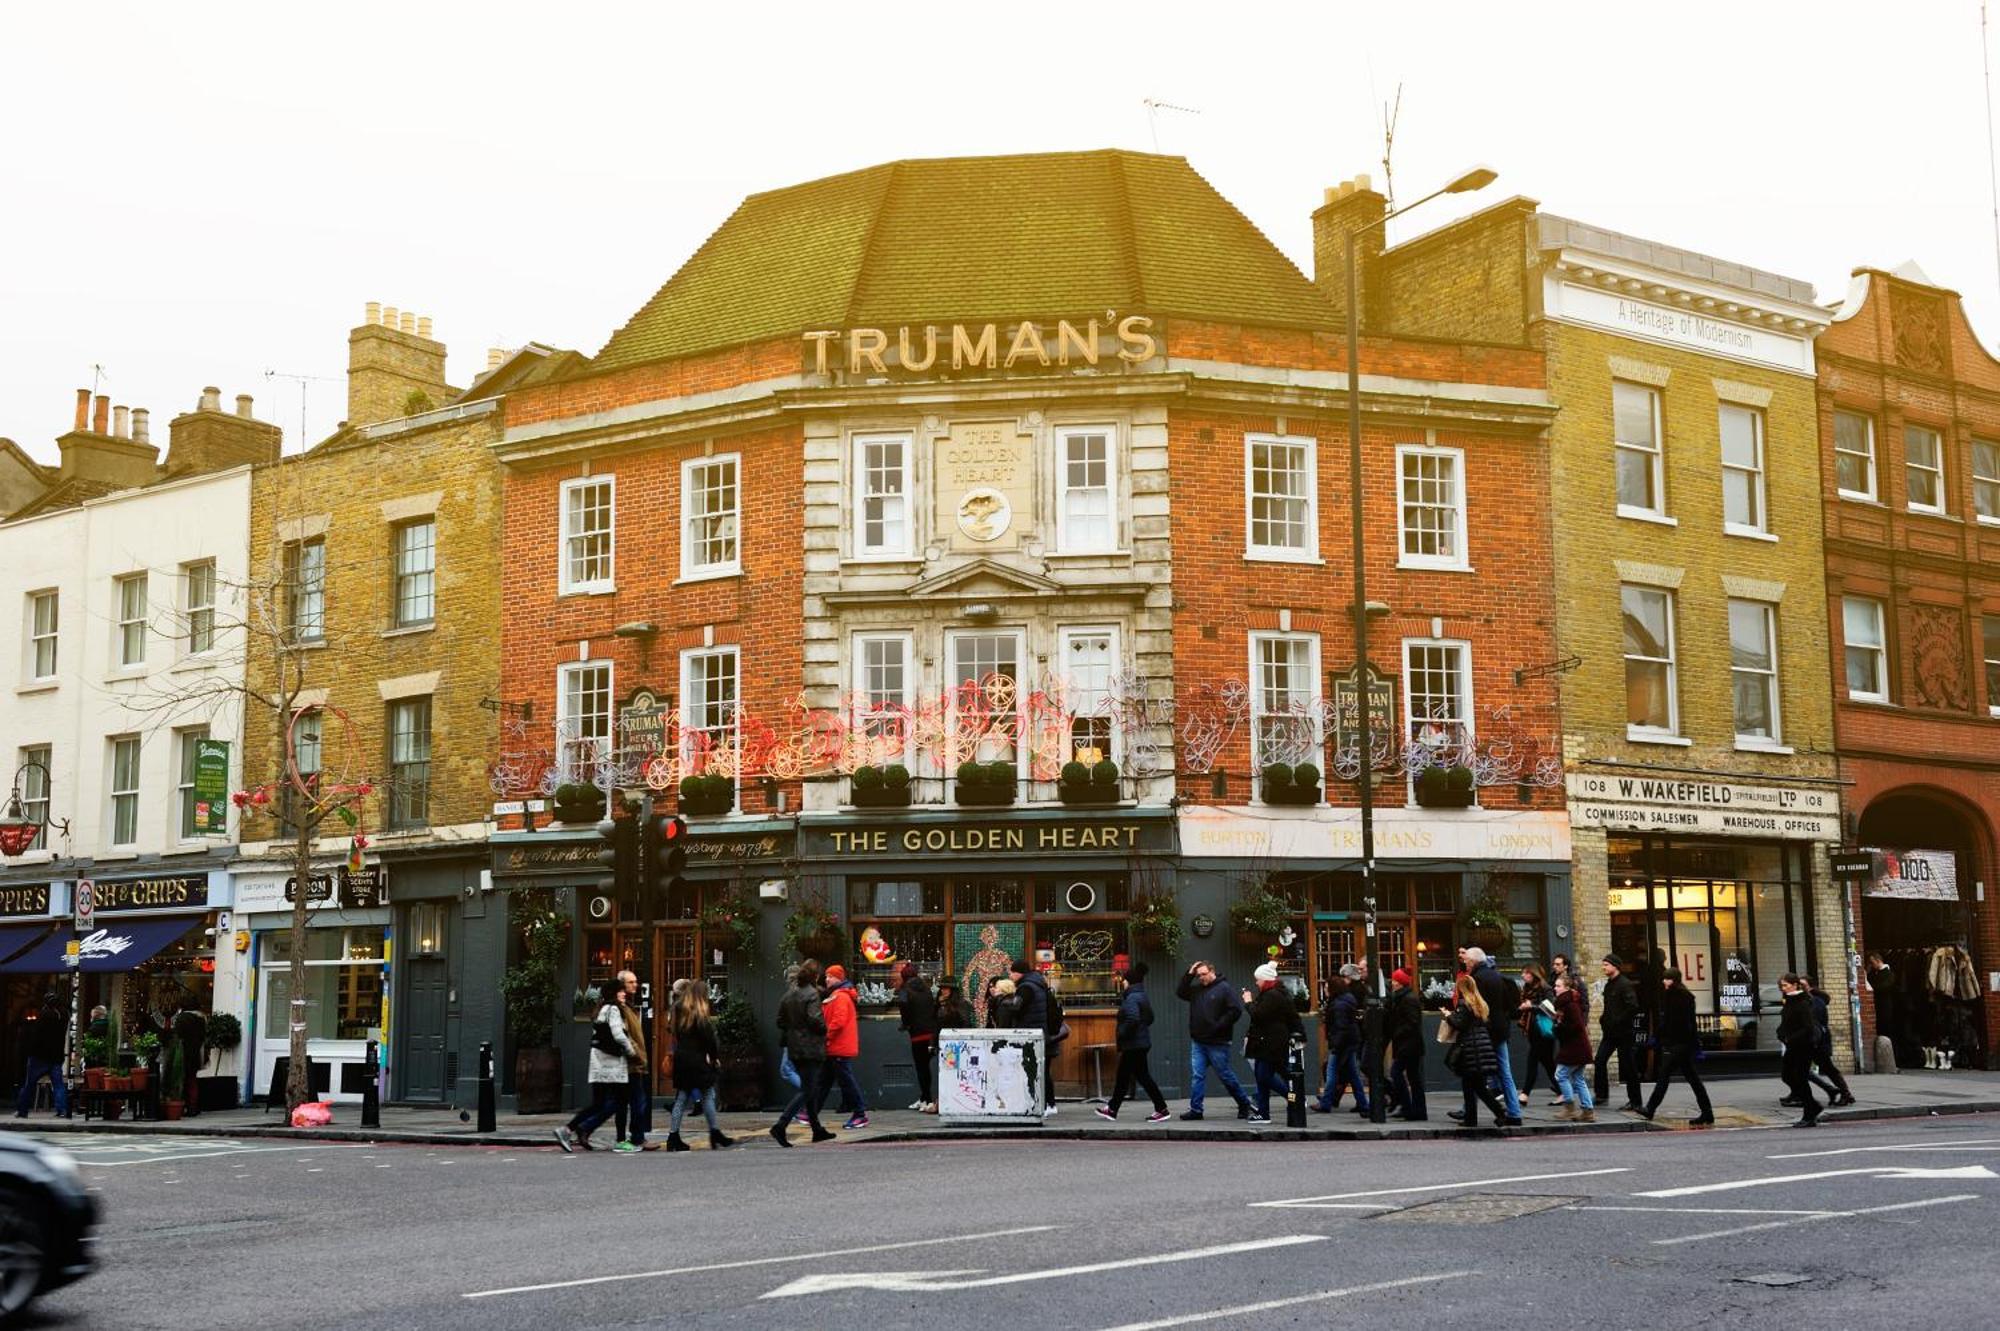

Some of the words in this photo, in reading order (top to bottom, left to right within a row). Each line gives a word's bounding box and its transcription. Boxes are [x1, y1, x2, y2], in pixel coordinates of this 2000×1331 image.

[1618, 301, 1626, 321] A
[1630, 302, 1674, 335] Heritage
[1680, 316, 1691, 336] of
[1695, 316, 1752, 349] Modernism
[802, 309, 1156, 375] TRUMAN'S
[965, 430, 1001, 445] THE
[947, 448, 1022, 464] GOLDEN
[953, 468, 1015, 483] HEART
[1584, 780, 1606, 792] 108
[1805, 796, 1822, 806] 108
[1585, 808, 1646, 822] COMMISSION
[1651, 812, 1698, 825] SALESMEN
[1785, 820, 1821, 832] OFFICES
[830, 832, 888, 851] THE
[903, 829, 1024, 850] GOLDEN
[1039, 827, 1141, 848] HEART
[1901, 861, 1928, 878] 106
[80, 890, 91, 905] 20
[95, 885, 116, 907] SH
[131, 879, 188, 905] CHIPS
[1723, 985, 1747, 996] FURTHER
